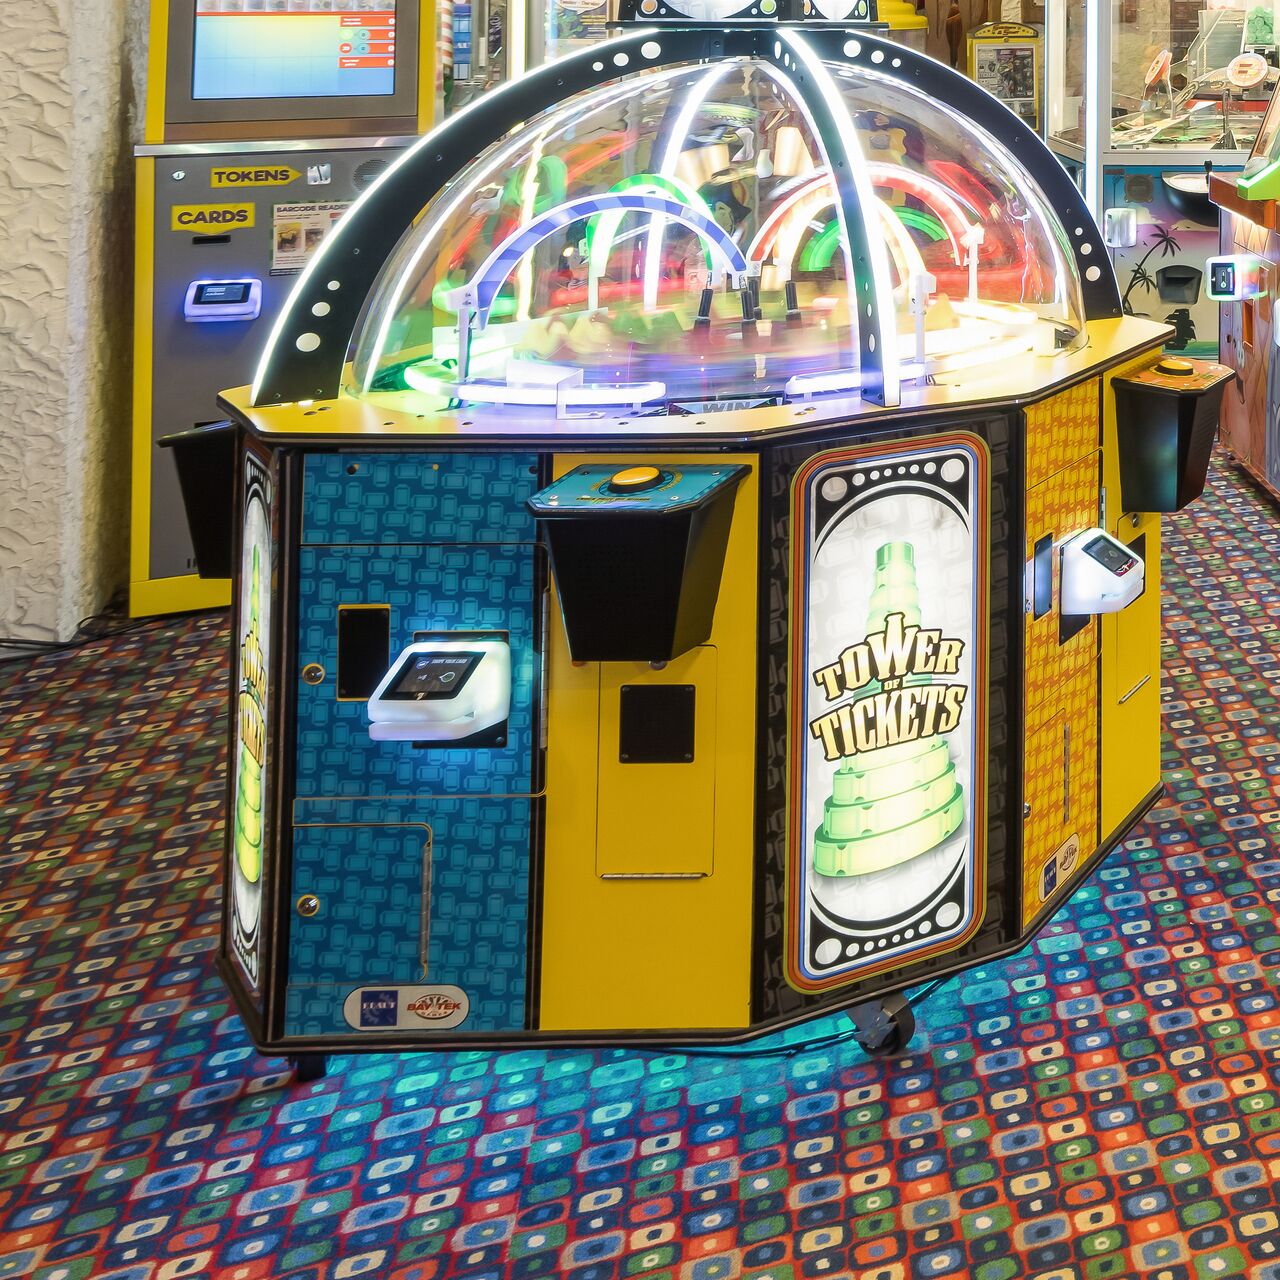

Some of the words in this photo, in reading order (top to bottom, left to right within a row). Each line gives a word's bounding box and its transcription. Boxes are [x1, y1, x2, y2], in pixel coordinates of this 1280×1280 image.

[214, 170, 290, 184] TOKENS
[177, 210, 249, 226] CARDS
[701, 402, 751, 414] WIN
[813, 612, 966, 702] TOWER
[883, 677, 901, 692] OF
[809, 683, 969, 763] TICKETS
[406, 1001, 432, 1012] BAY
[436, 1001, 461, 1011] TEK
